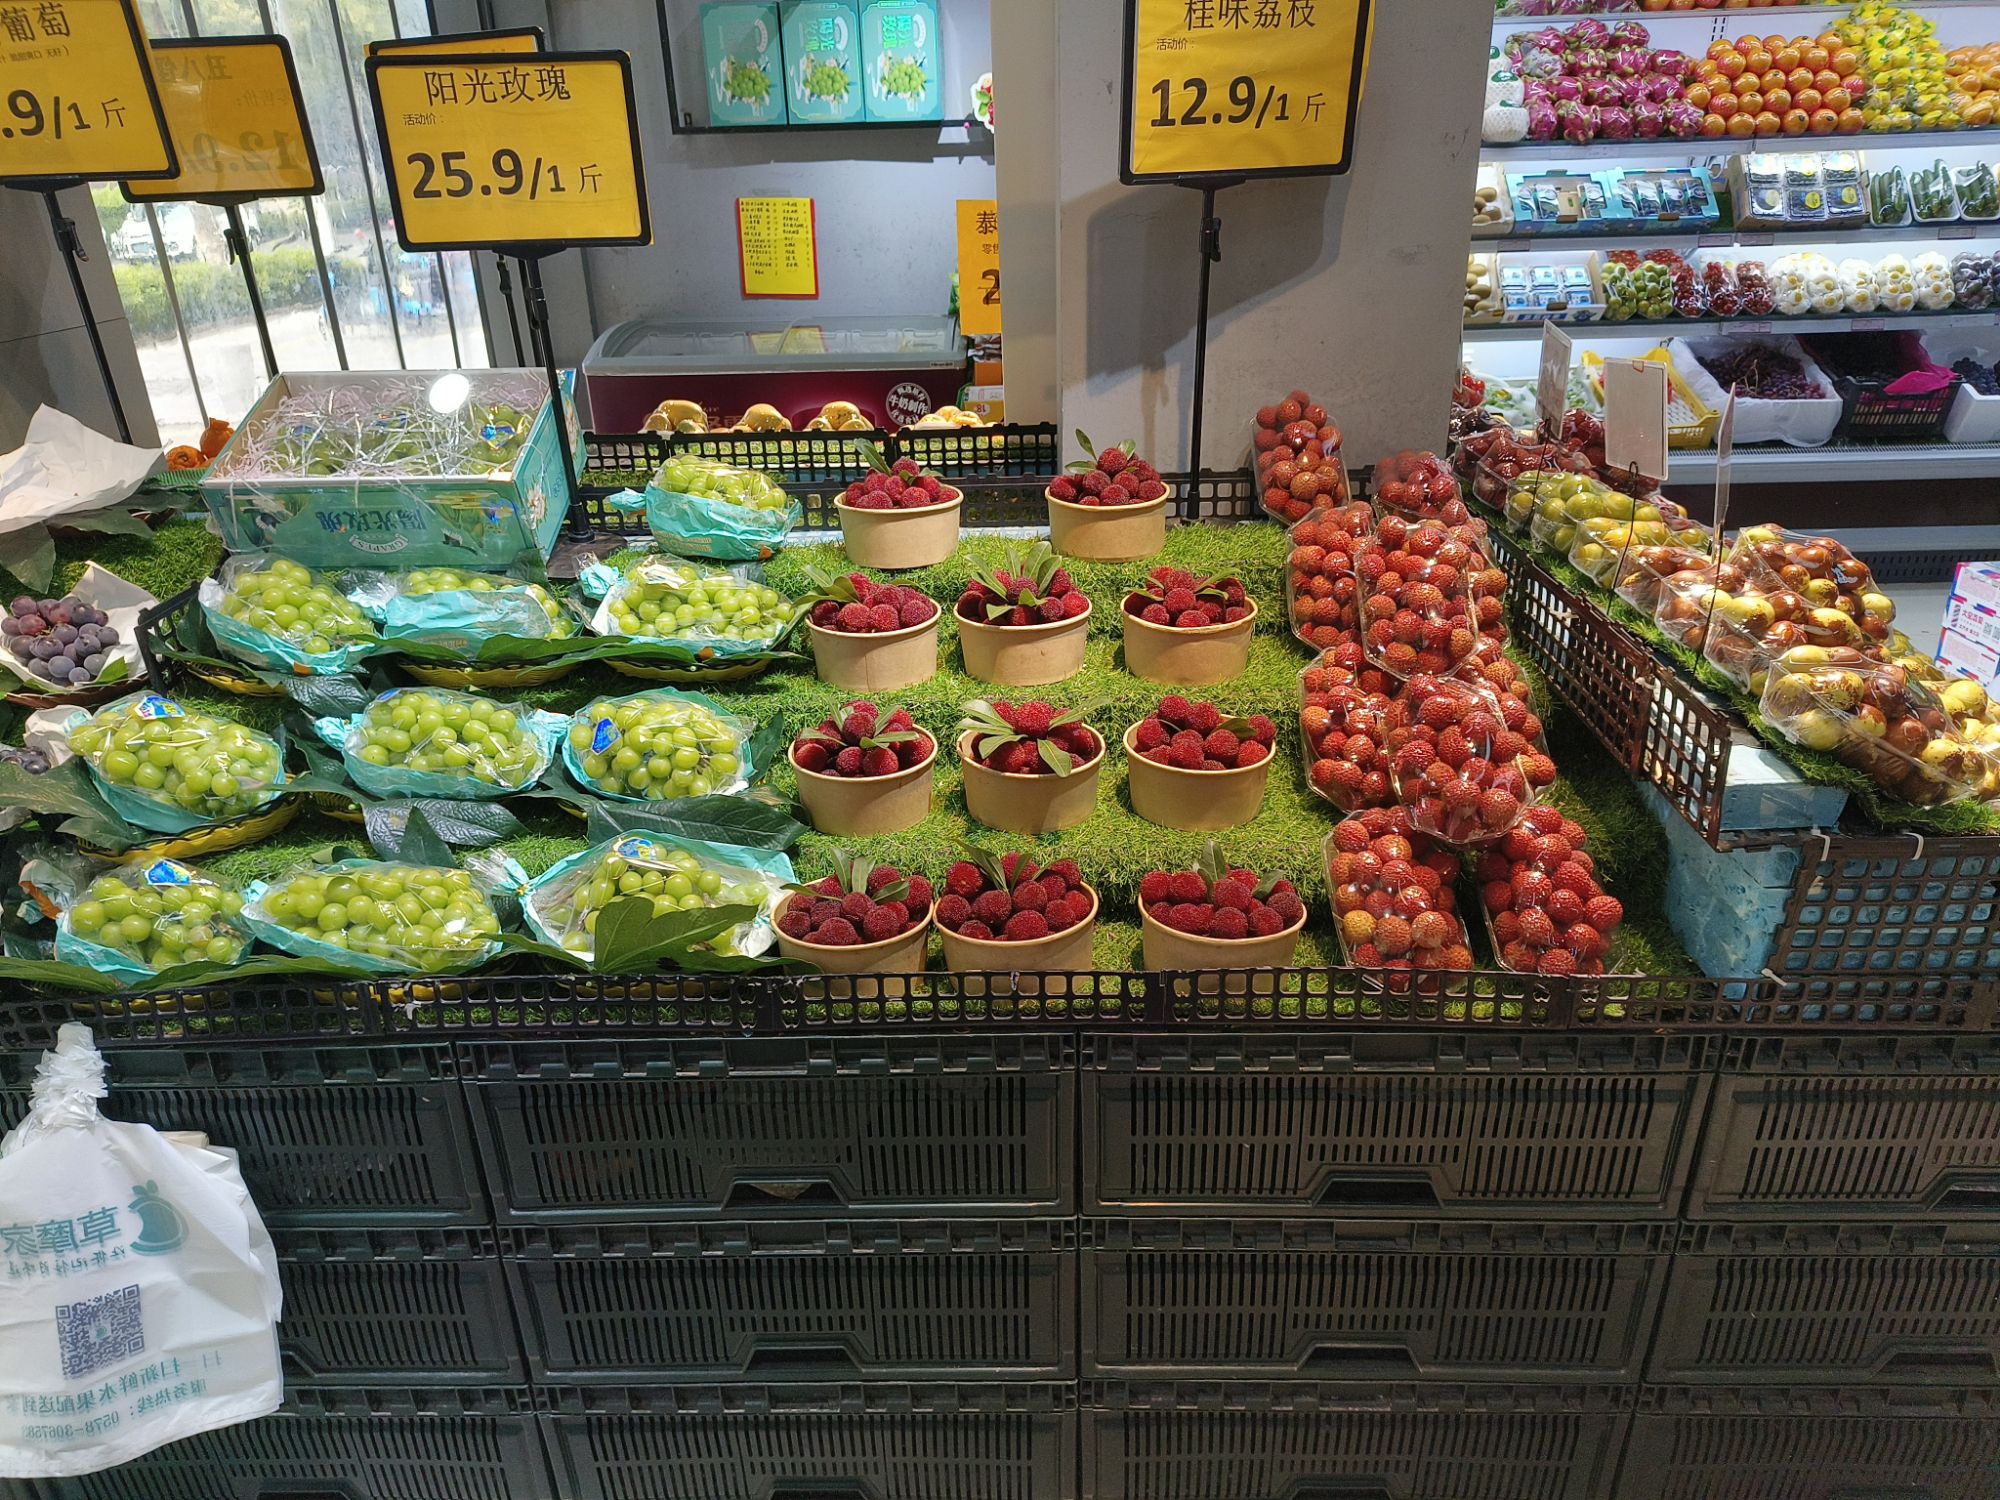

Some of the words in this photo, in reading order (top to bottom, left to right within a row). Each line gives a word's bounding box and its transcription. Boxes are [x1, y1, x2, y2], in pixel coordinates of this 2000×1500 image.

[0, 2, 71, 42] 葡萄
[1184, 0, 1316, 31] 桂味荔枝
[424, 65, 571, 106] 阳光玫瑰
[1151, 75, 1290, 129] 12.9/1
[1301, 92, 1327, 123] 斤
[101, 98, 126, 128] 斤
[407, 148, 566, 200] 25.9/1
[579, 163, 602, 193] 斤
